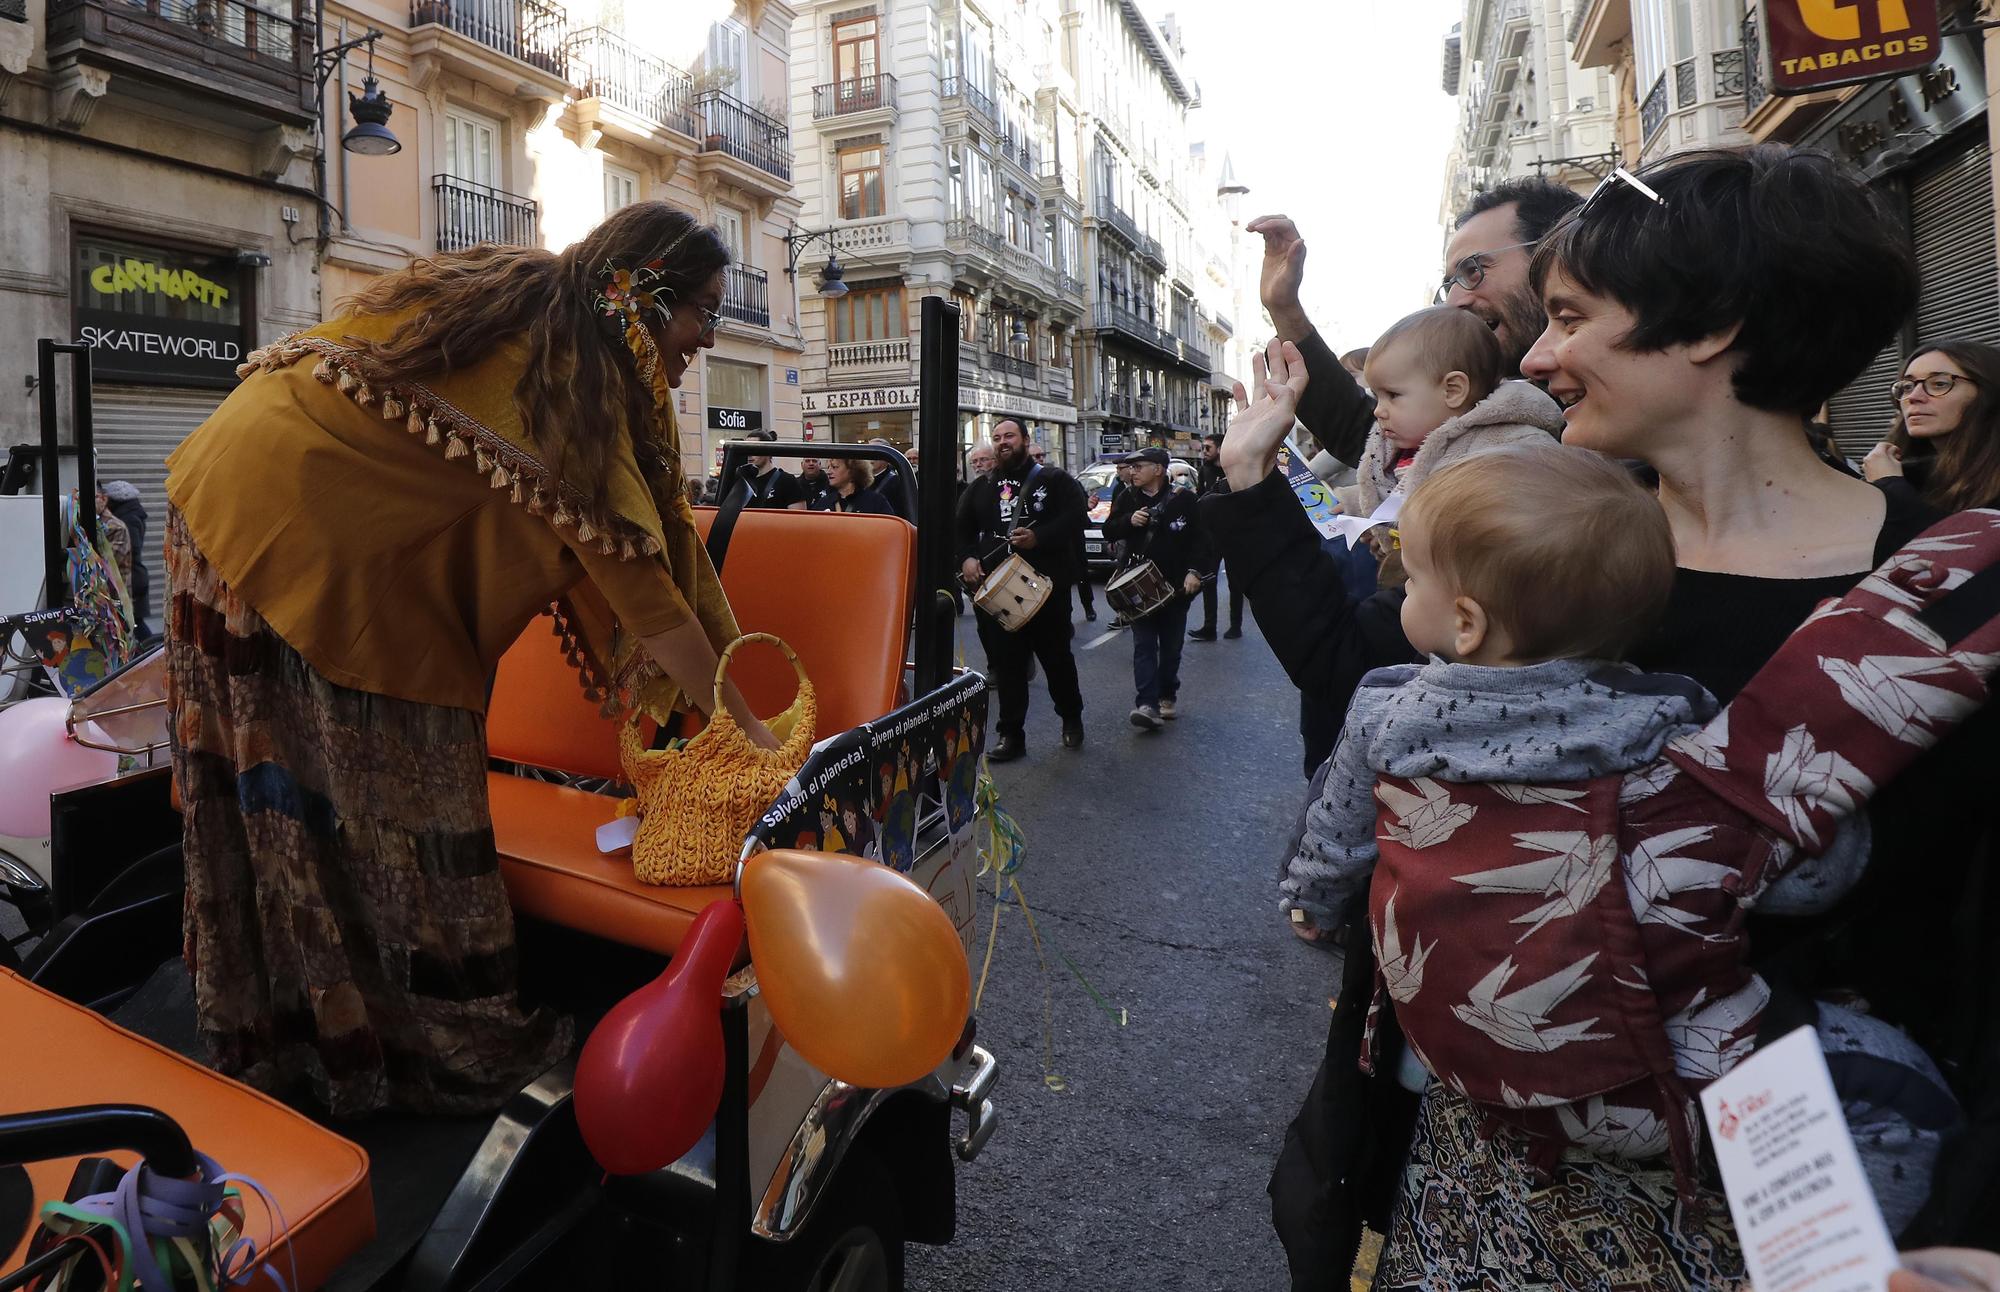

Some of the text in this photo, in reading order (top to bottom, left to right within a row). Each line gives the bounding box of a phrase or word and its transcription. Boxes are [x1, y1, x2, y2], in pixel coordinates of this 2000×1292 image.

[1781, 35, 1929, 76] TABACOS
[90, 258, 229, 309] CARHARTT
[80, 326, 239, 361] SKATEWORLD
[719, 410, 746, 428] Sofia
[932, 678, 986, 718] Salvem el planeta!
[871, 708, 930, 748] alvem el planeta!
[762, 746, 865, 828] Salvem el planeta!
